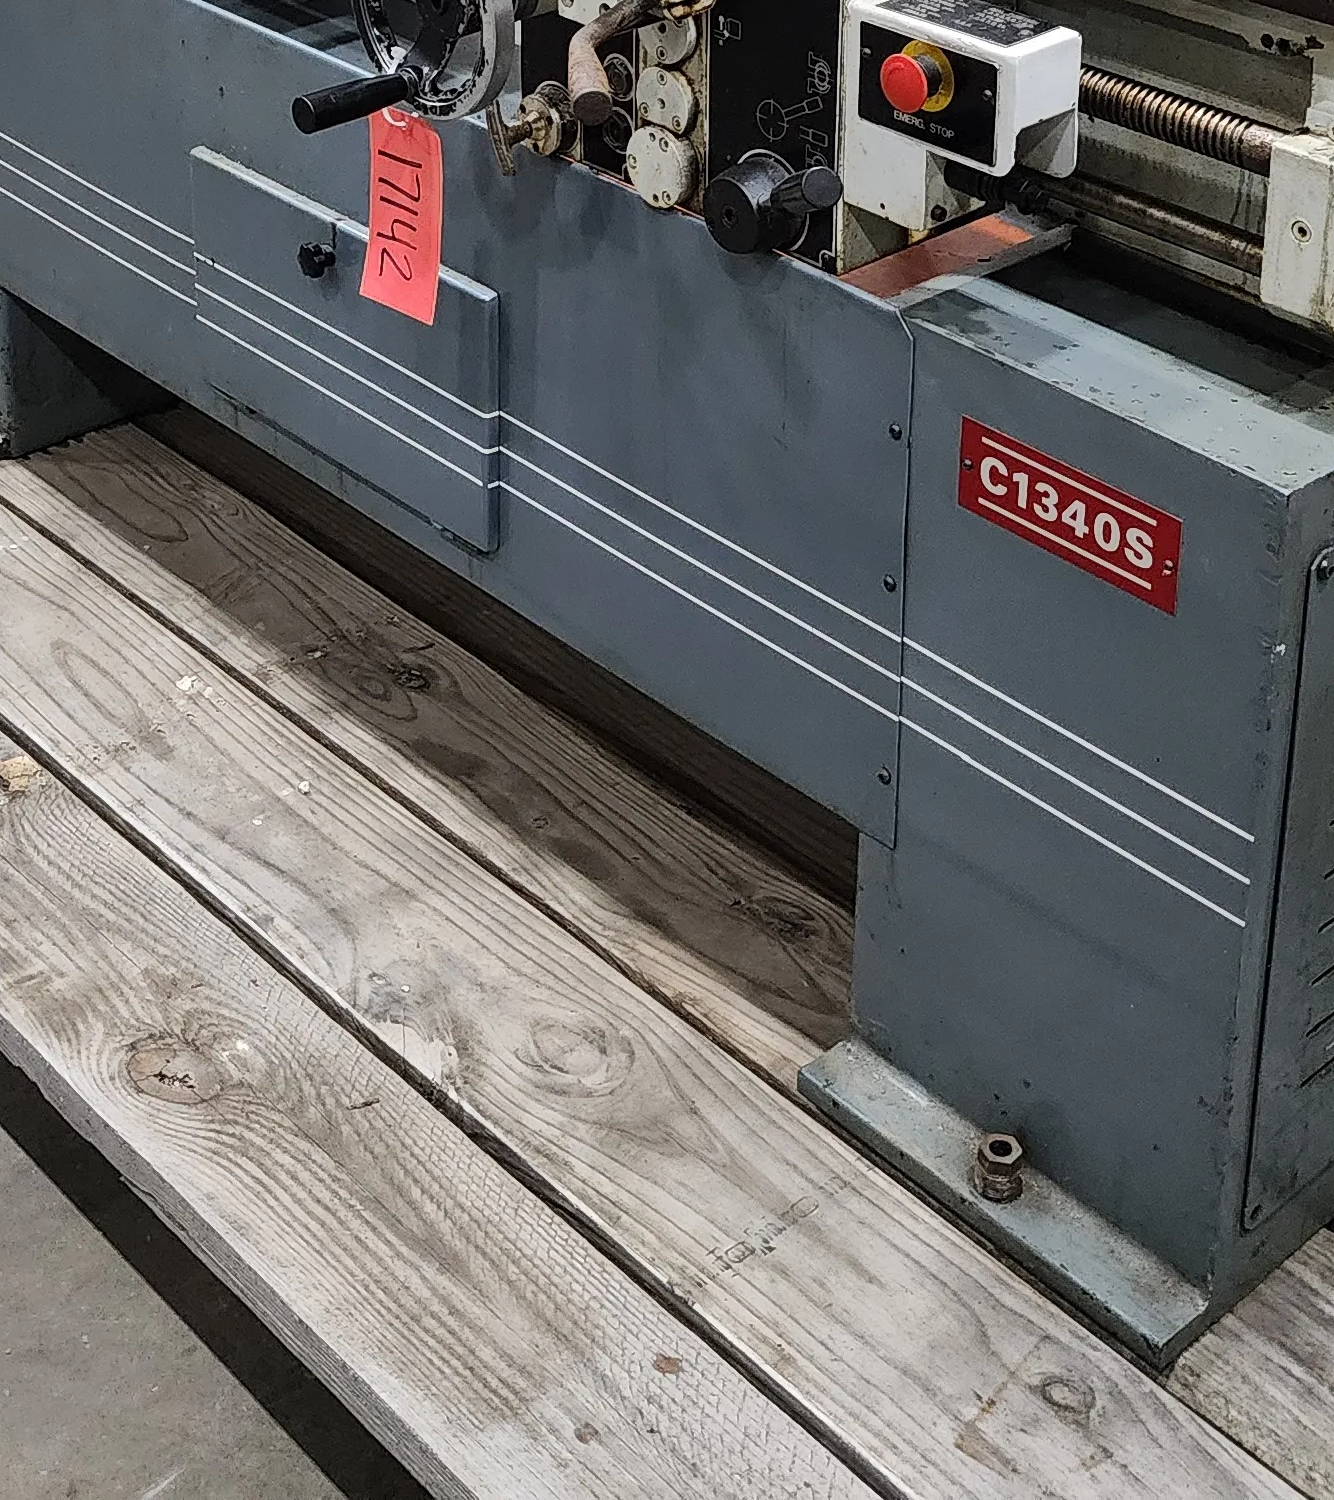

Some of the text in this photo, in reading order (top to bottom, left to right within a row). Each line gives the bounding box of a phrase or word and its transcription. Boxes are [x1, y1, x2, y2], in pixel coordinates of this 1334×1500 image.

[893, 110, 955, 139] EMERG. STOP
[376, 148, 423, 282] 17142
[979, 456, 1154, 570] C1340S
